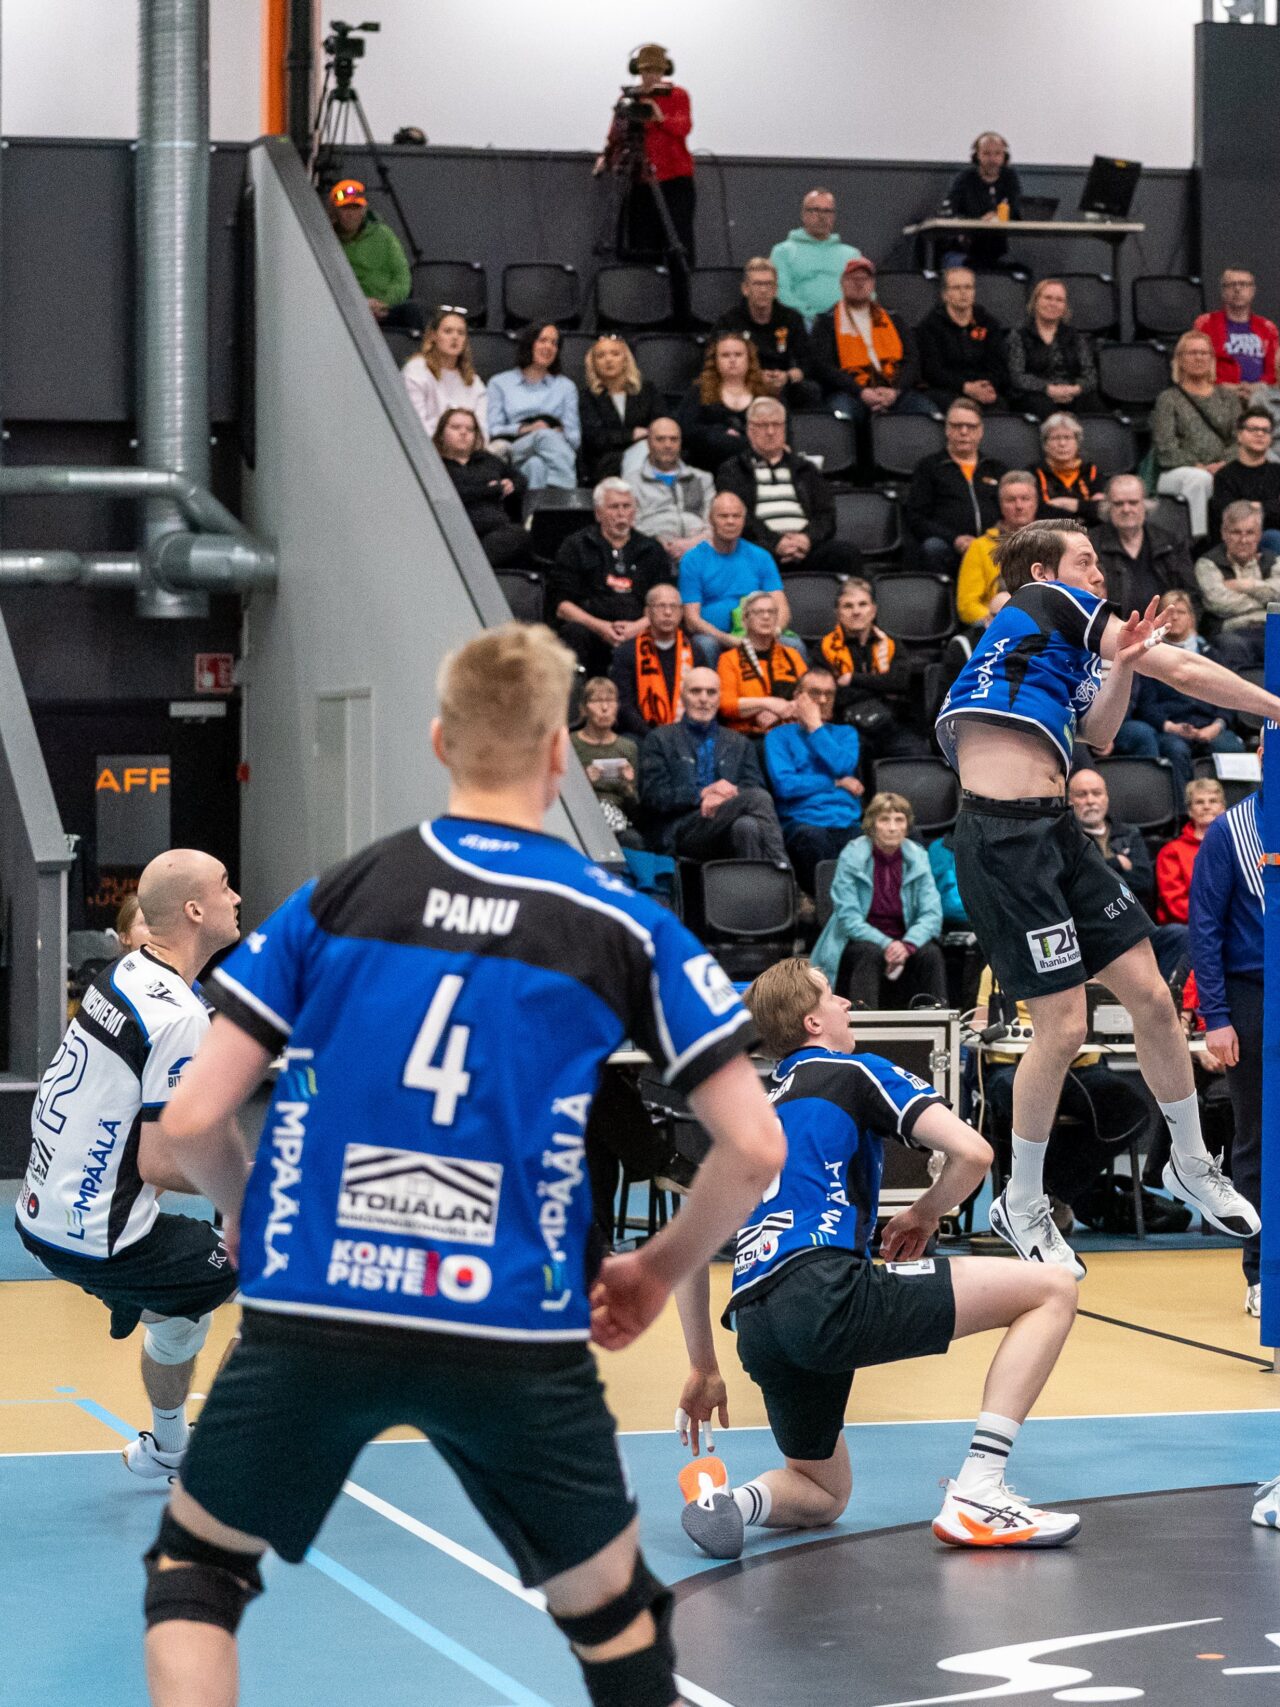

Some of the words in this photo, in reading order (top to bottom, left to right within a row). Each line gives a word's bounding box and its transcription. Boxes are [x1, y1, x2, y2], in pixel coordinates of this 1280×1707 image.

[422, 888, 521, 936] PANU
[402, 974, 471, 1127] 4
[343, 1189, 493, 1225] TOIJALAN
[331, 1239, 427, 1272] KONE
[326, 1261, 425, 1297] PISTE
